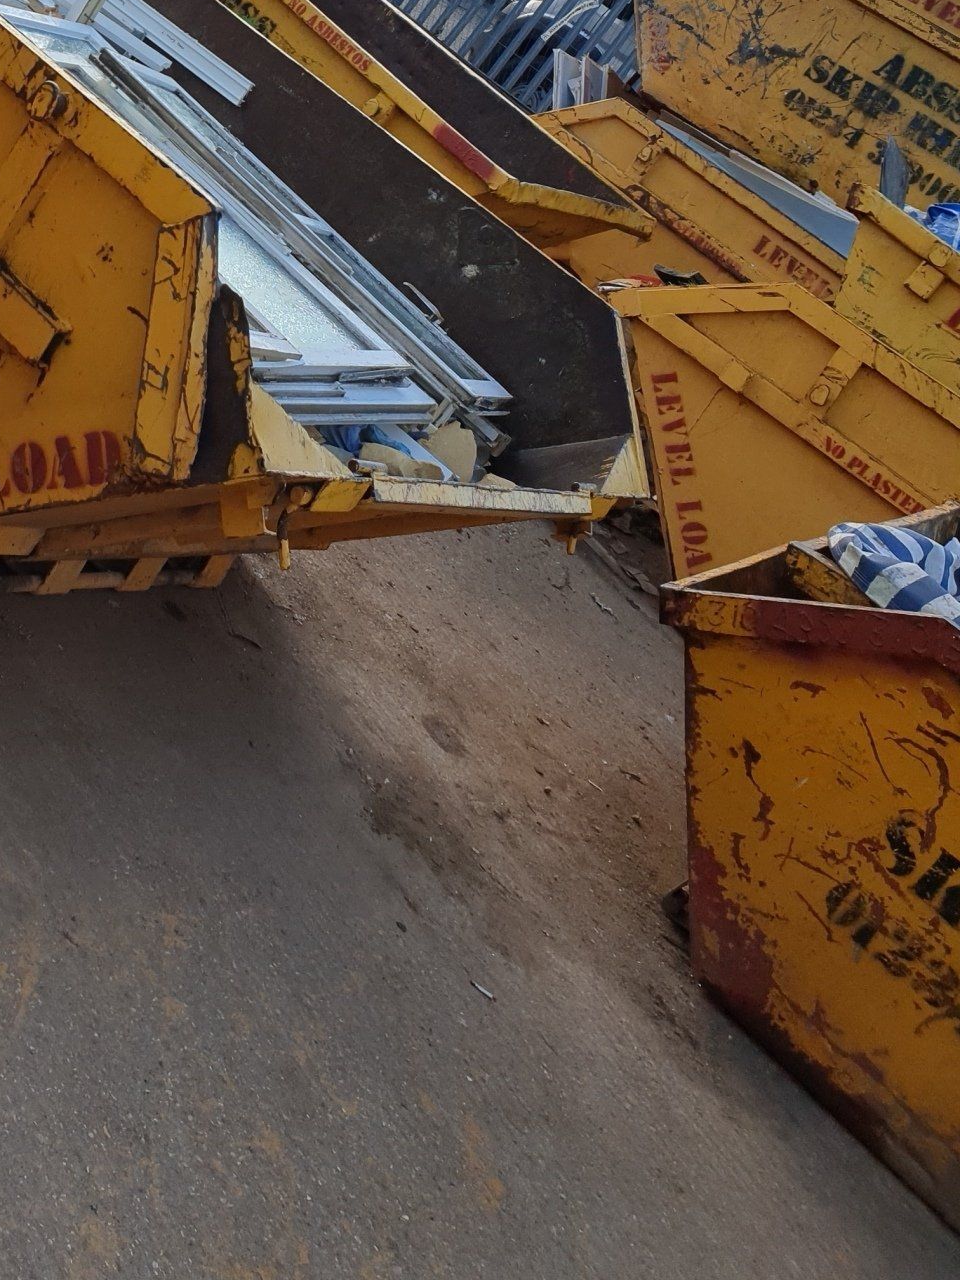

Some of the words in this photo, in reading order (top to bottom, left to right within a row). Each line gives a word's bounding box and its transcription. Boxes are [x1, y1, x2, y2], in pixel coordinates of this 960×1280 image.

[305, 14, 372, 72] ASBESTOS
[804, 55, 900, 119] SKIP
[651, 372, 697, 486] LEVEL
[824, 436, 846, 459] NO
